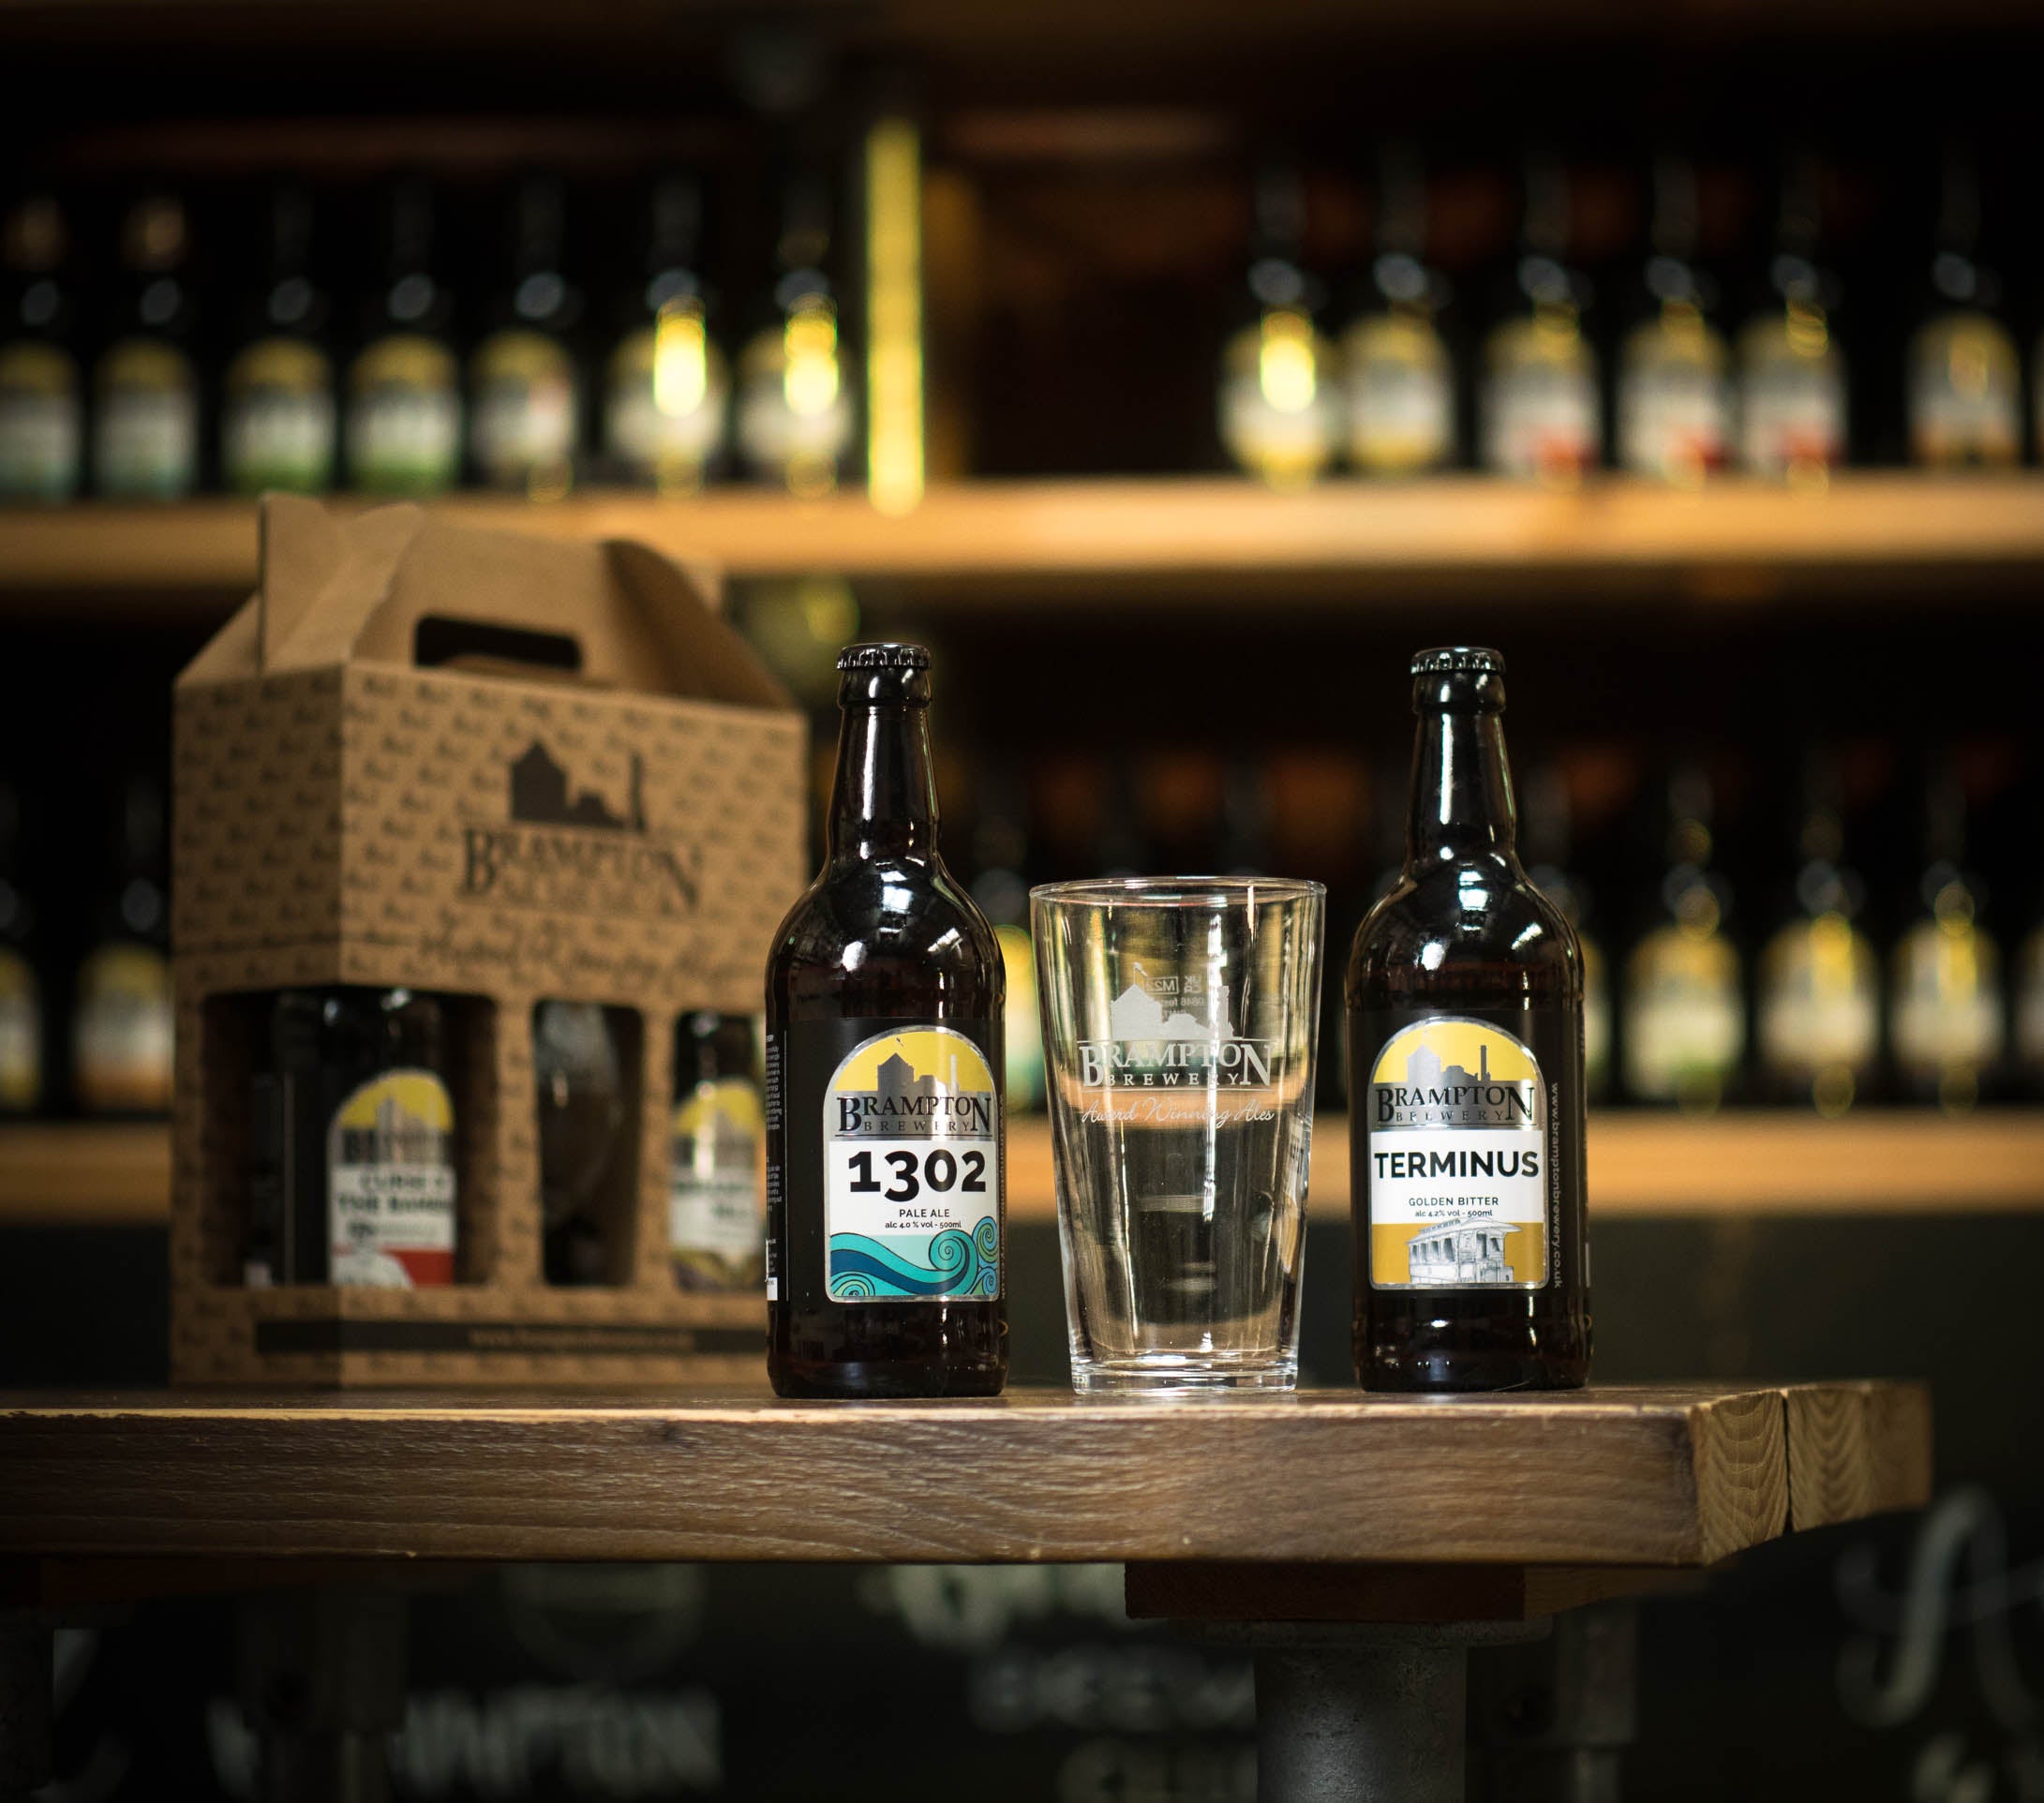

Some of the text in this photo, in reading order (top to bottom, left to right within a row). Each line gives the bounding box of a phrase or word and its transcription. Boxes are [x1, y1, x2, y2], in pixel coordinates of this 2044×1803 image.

[1079, 1043, 1275, 1087] BRAMPTON
[1109, 1073, 1240, 1086] BREWERY
[837, 1095, 992, 1132] BRAMPTON
[1082, 1097, 1275, 1128] Award Winning Ales
[1377, 1085, 1535, 1123] BRAMPTON
[1395, 1110, 1505, 1122] BREWERY
[864, 1121, 971, 1132] BREWERY
[1374, 1151, 1540, 1178] TERMINUS
[848, 1149, 987, 1202] 1302
[1551, 1081, 1561, 1289] www.bramptonbrewery.co.uk
[1409, 1197, 1499, 1206] GOLDEN BITTER
[899, 1209, 950, 1217] PALE ALE
[1468, 1209, 1493, 1218] 500ml
[939, 1221, 962, 1229] 500ml
